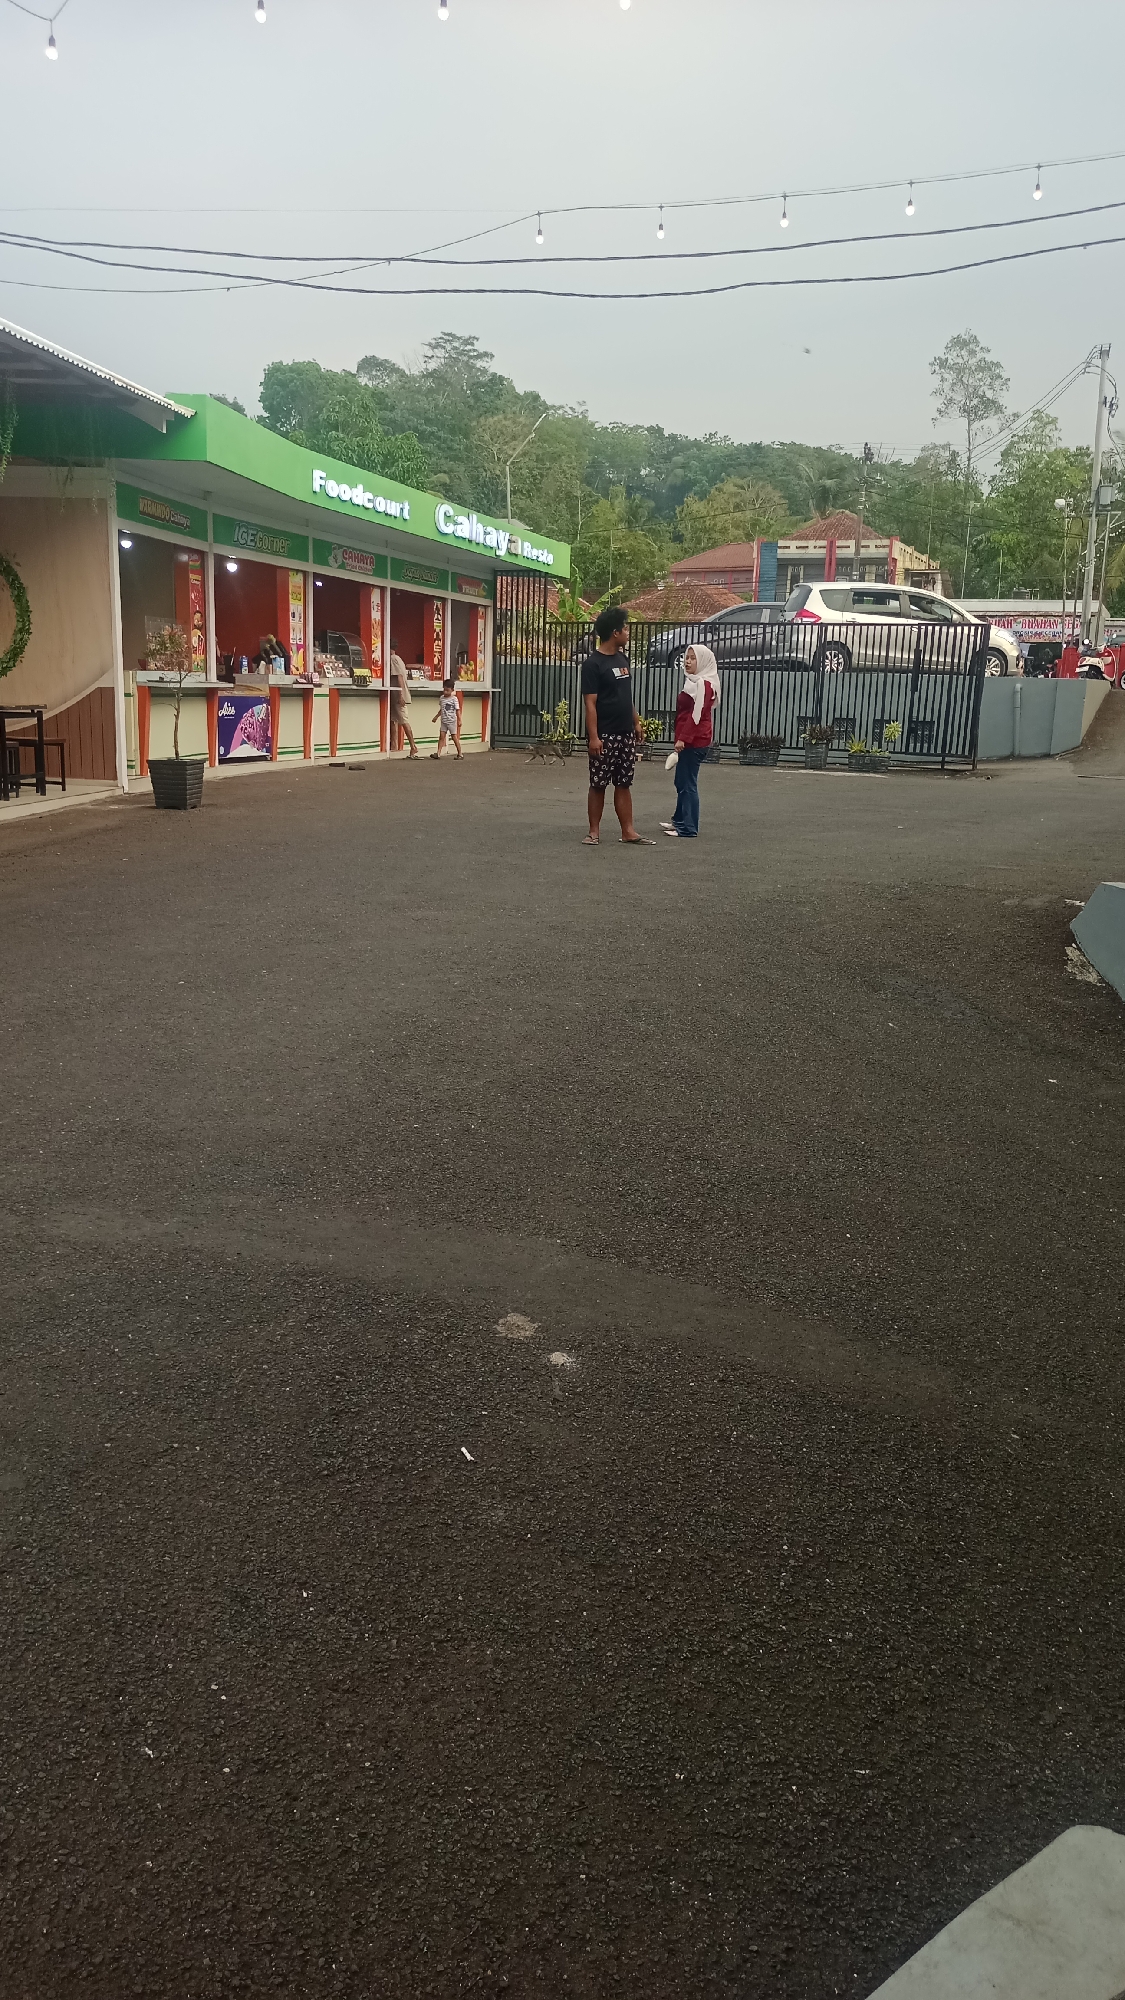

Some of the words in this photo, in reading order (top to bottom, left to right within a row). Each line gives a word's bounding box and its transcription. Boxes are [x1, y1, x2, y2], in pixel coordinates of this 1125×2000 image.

[312, 469, 410, 521] Foodcourt
[233, 525, 257, 547] ICE
[256, 531, 290, 554] Corner
[434, 503, 521, 556] Cahaya
[523, 541, 554, 565] Resto
[342, 549, 375, 567] CAHAYA
